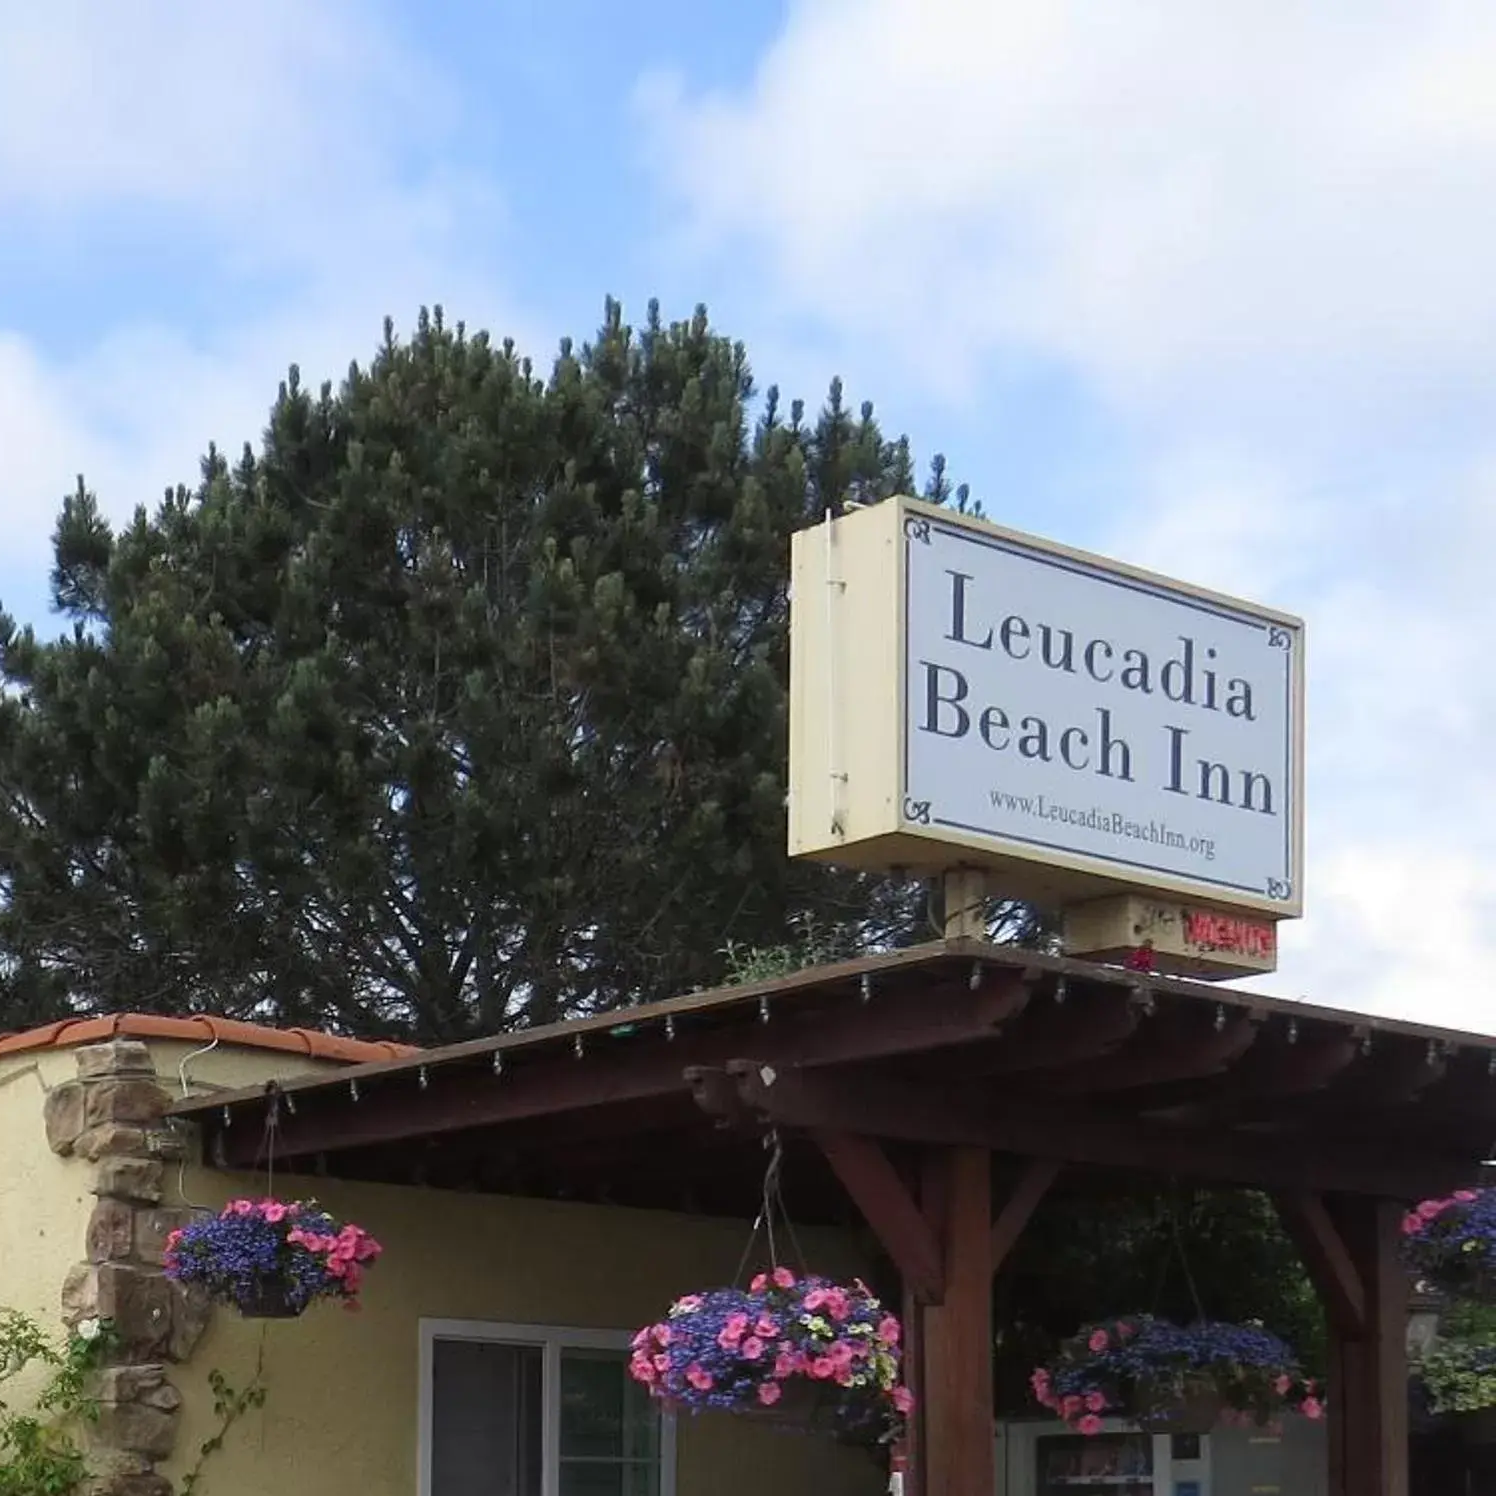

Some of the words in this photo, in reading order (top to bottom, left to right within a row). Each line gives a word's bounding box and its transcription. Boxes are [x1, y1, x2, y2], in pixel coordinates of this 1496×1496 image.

[945, 569, 1257, 721] Leucadia
[918, 660, 1135, 782] Beach
[1161, 725, 1278, 816] Inn
[989, 789, 1216, 860] www.LeucadiaBeachInn.org
